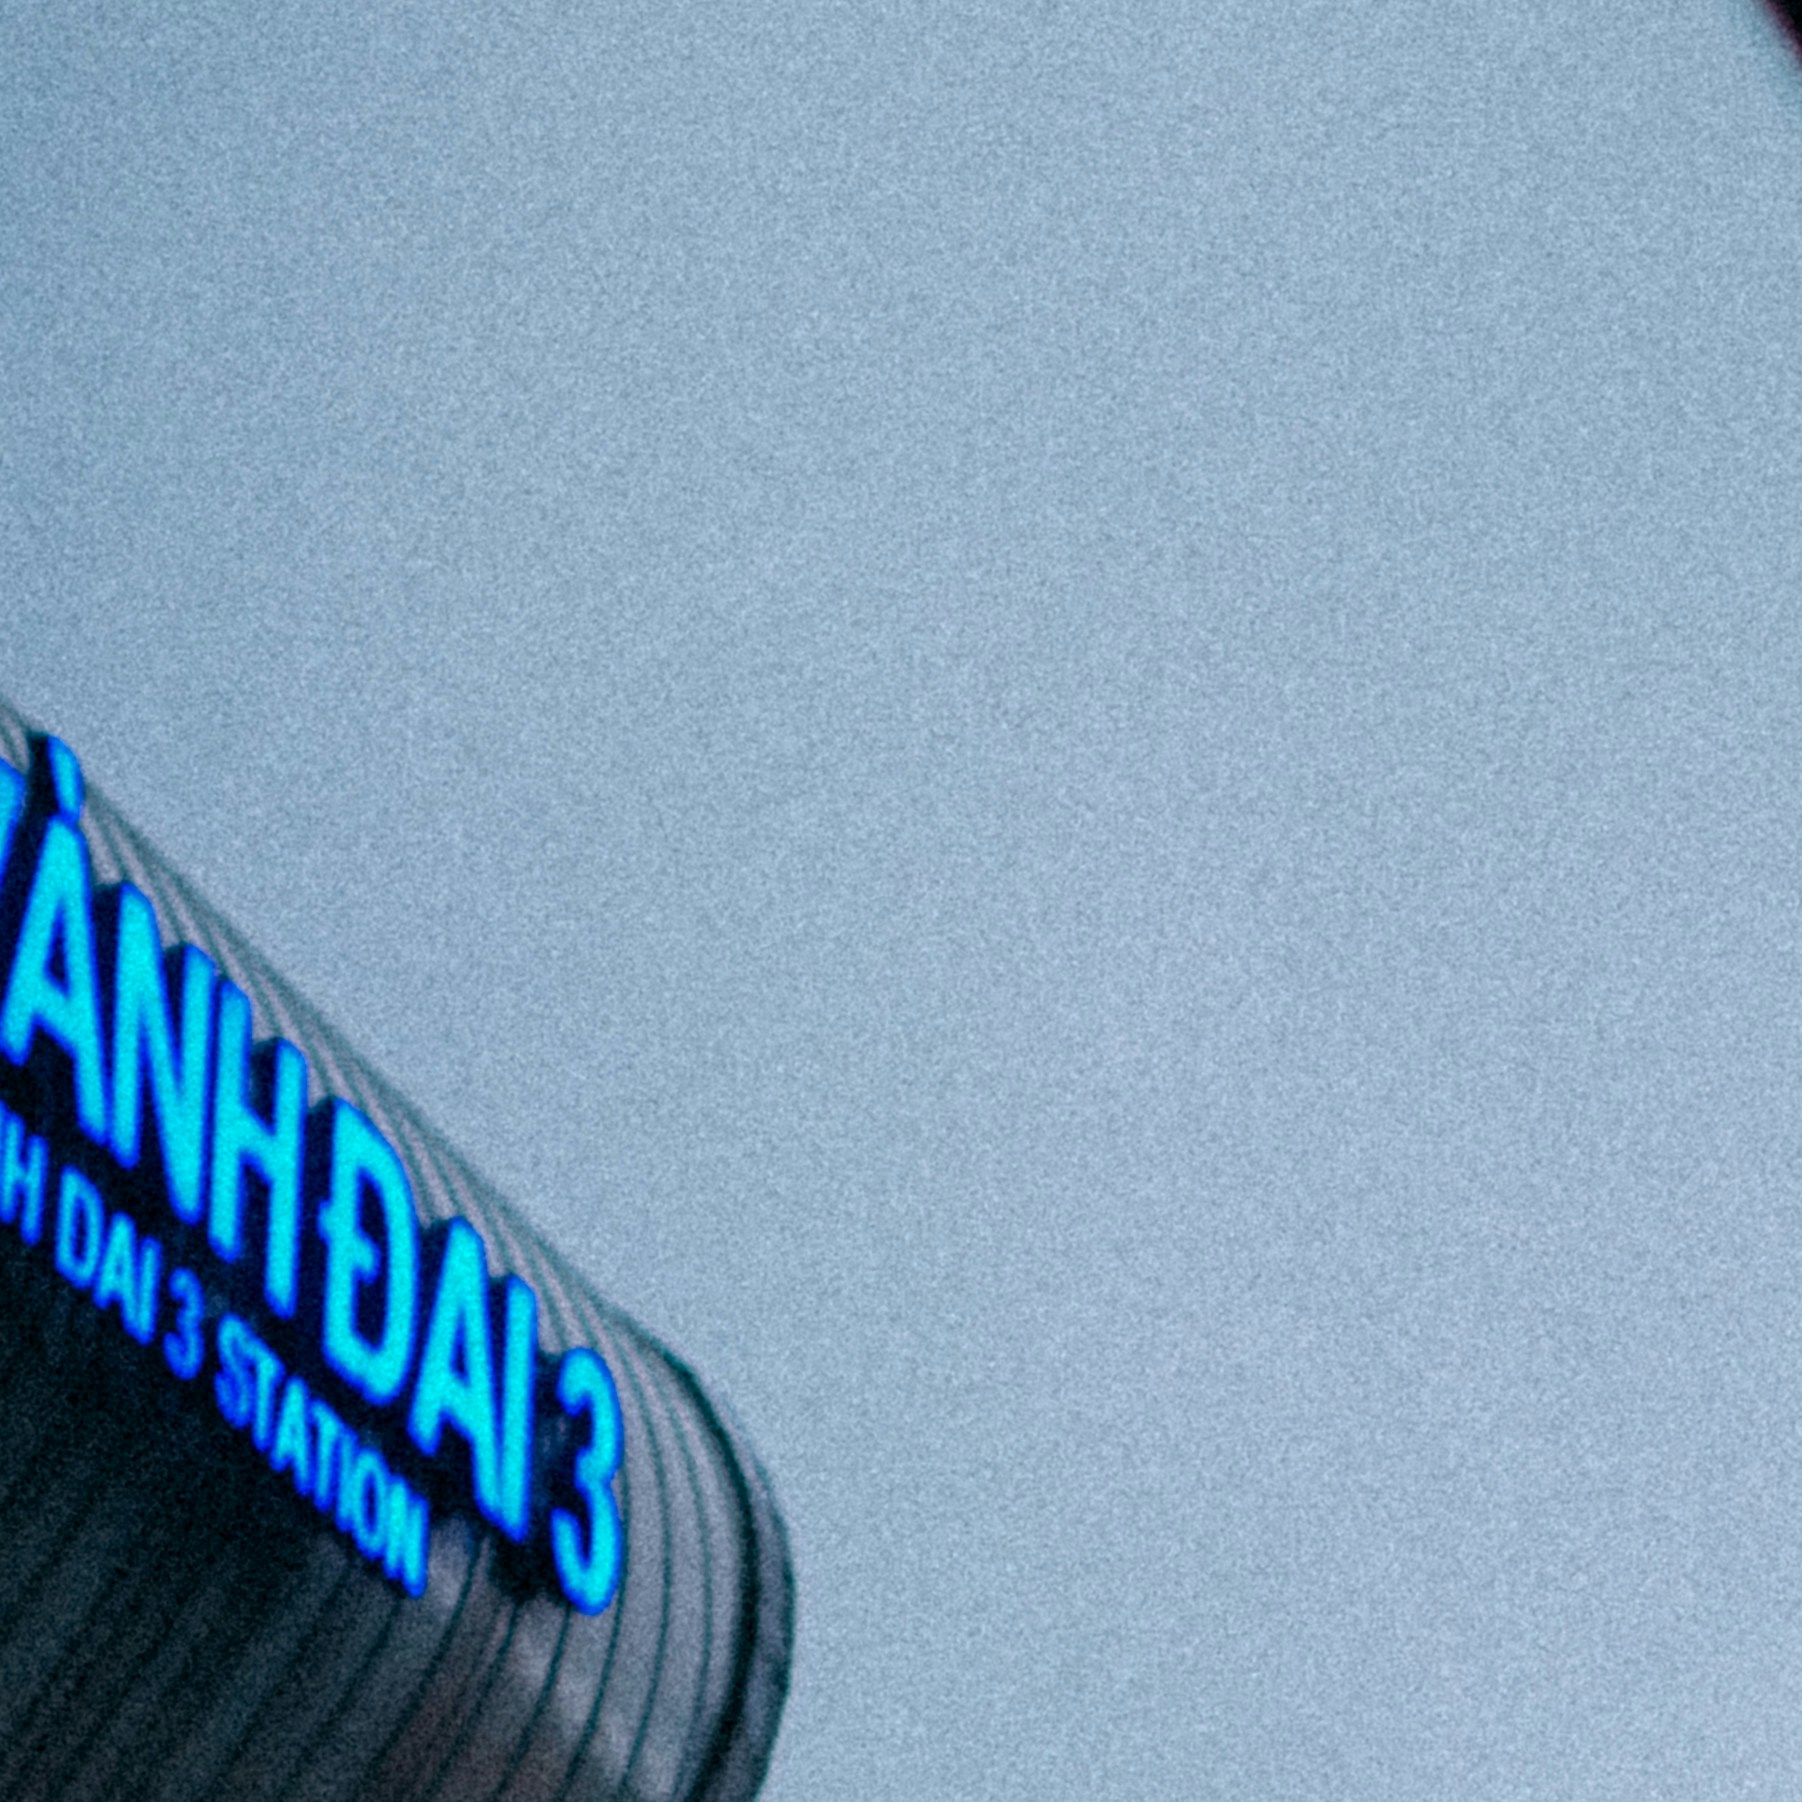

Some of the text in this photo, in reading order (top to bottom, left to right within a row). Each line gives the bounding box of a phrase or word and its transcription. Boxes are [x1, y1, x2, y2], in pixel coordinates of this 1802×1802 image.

[0, 734, 626, 1616] ÀNH ĐAI 3
[0, 1098, 430, 1599] H DAI 3 STATION
